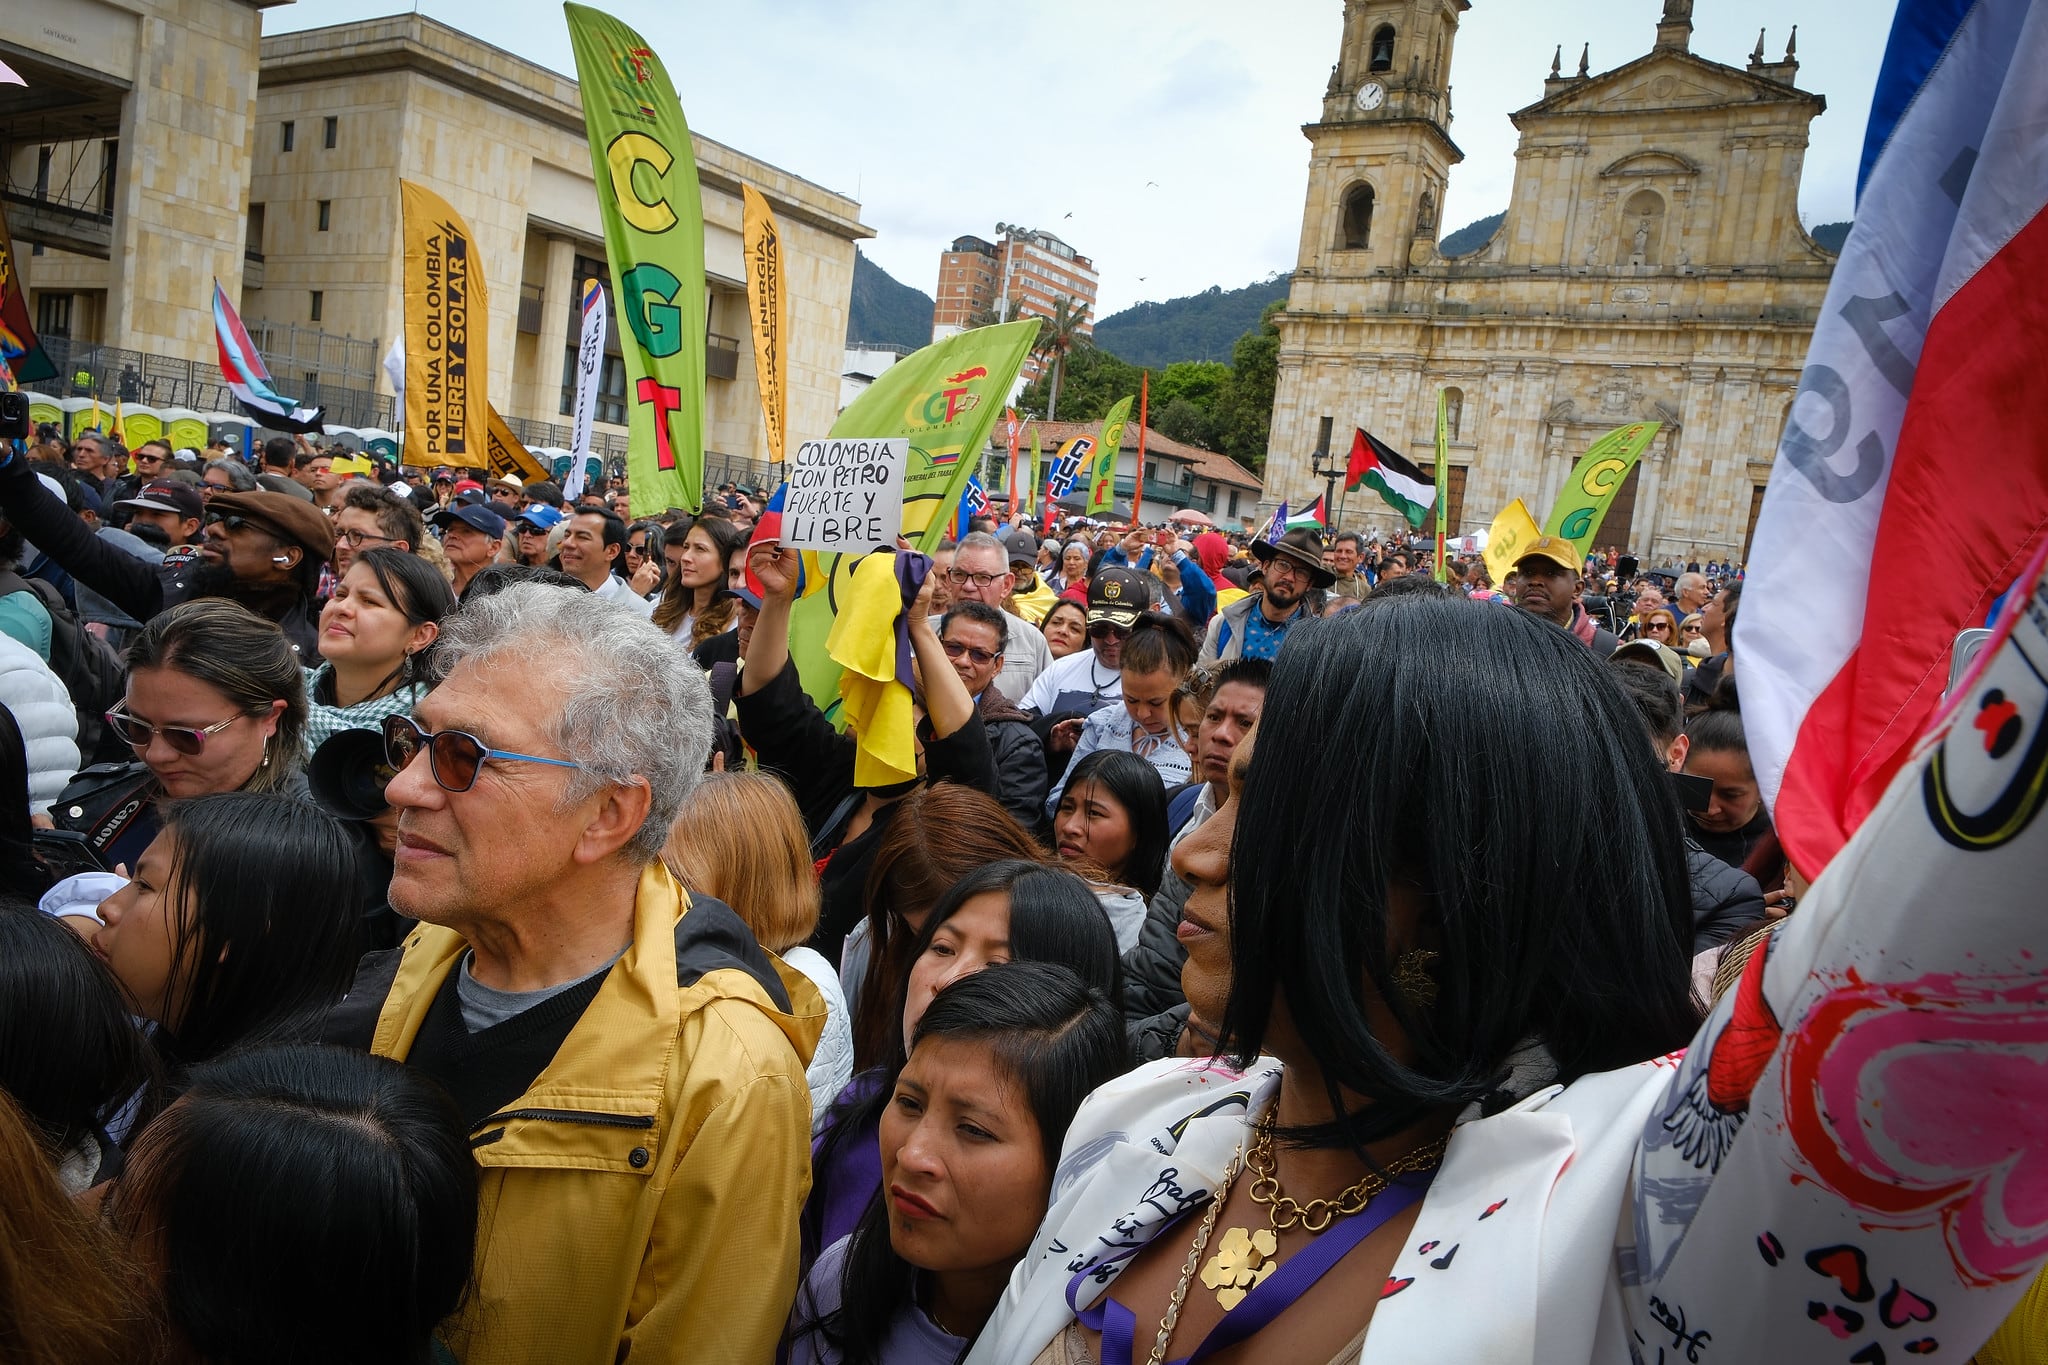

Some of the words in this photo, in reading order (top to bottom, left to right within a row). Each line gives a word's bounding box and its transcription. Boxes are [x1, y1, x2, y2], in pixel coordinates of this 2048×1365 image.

[426, 234, 442, 351] COLOMBIA
[449, 256, 466, 345] SOLAR
[427, 357, 442, 404] UNA
[448, 356, 465, 371] Y
[446, 375, 464, 441] LIBRE
[904, 387, 968, 427] CGT
[427, 409, 441, 454] POR
[488, 429, 520, 473] LIBR
[791, 469, 827, 489] CON
[833, 463, 889, 488] PETRO
[1050, 439, 1092, 498] CUT
[787, 490, 853, 514] FUERTE
[863, 492, 876, 514] Y
[93, 800, 140, 847] Canon
